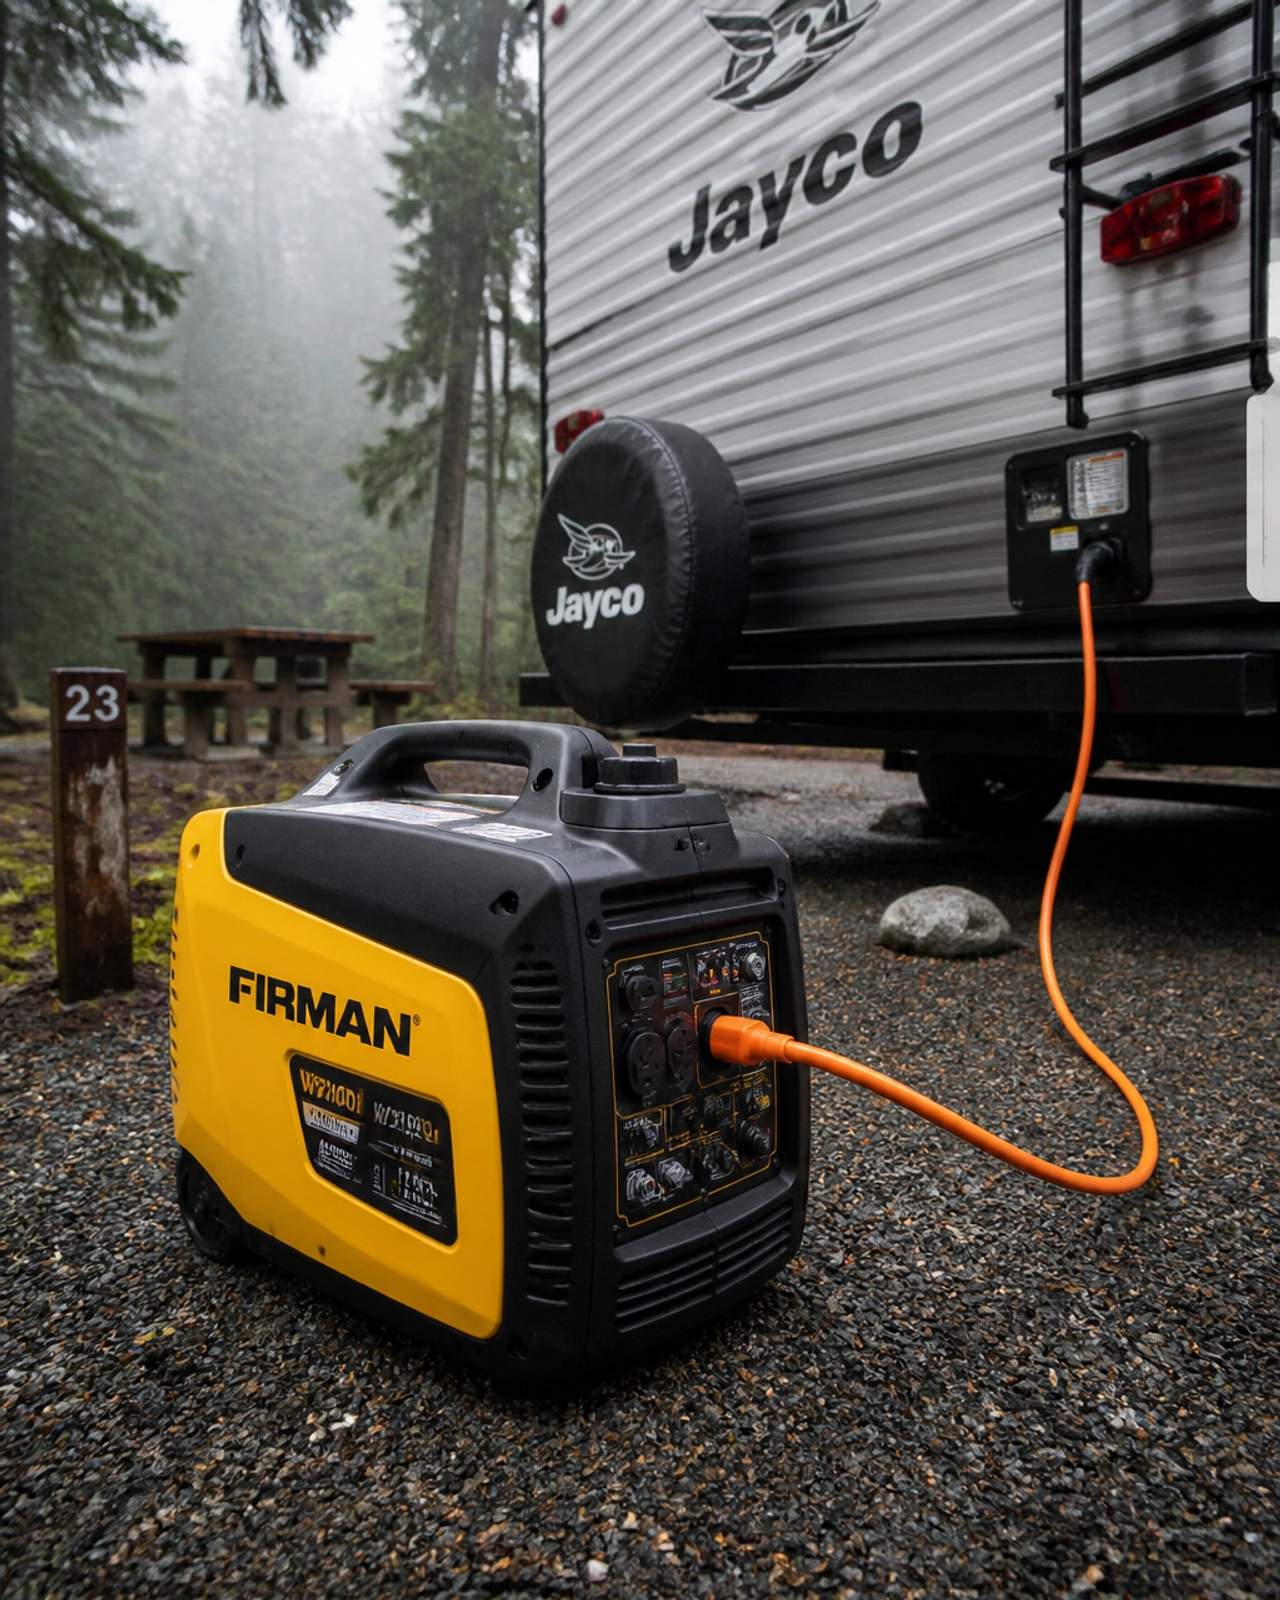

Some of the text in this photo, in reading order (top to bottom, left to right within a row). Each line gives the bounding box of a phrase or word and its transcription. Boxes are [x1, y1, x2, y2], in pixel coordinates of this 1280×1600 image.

[668, 101, 923, 272] Jayco
[546, 583, 645, 629] Jayco
[66, 684, 119, 722] 23
[229, 965, 411, 1057] FIRMAN
